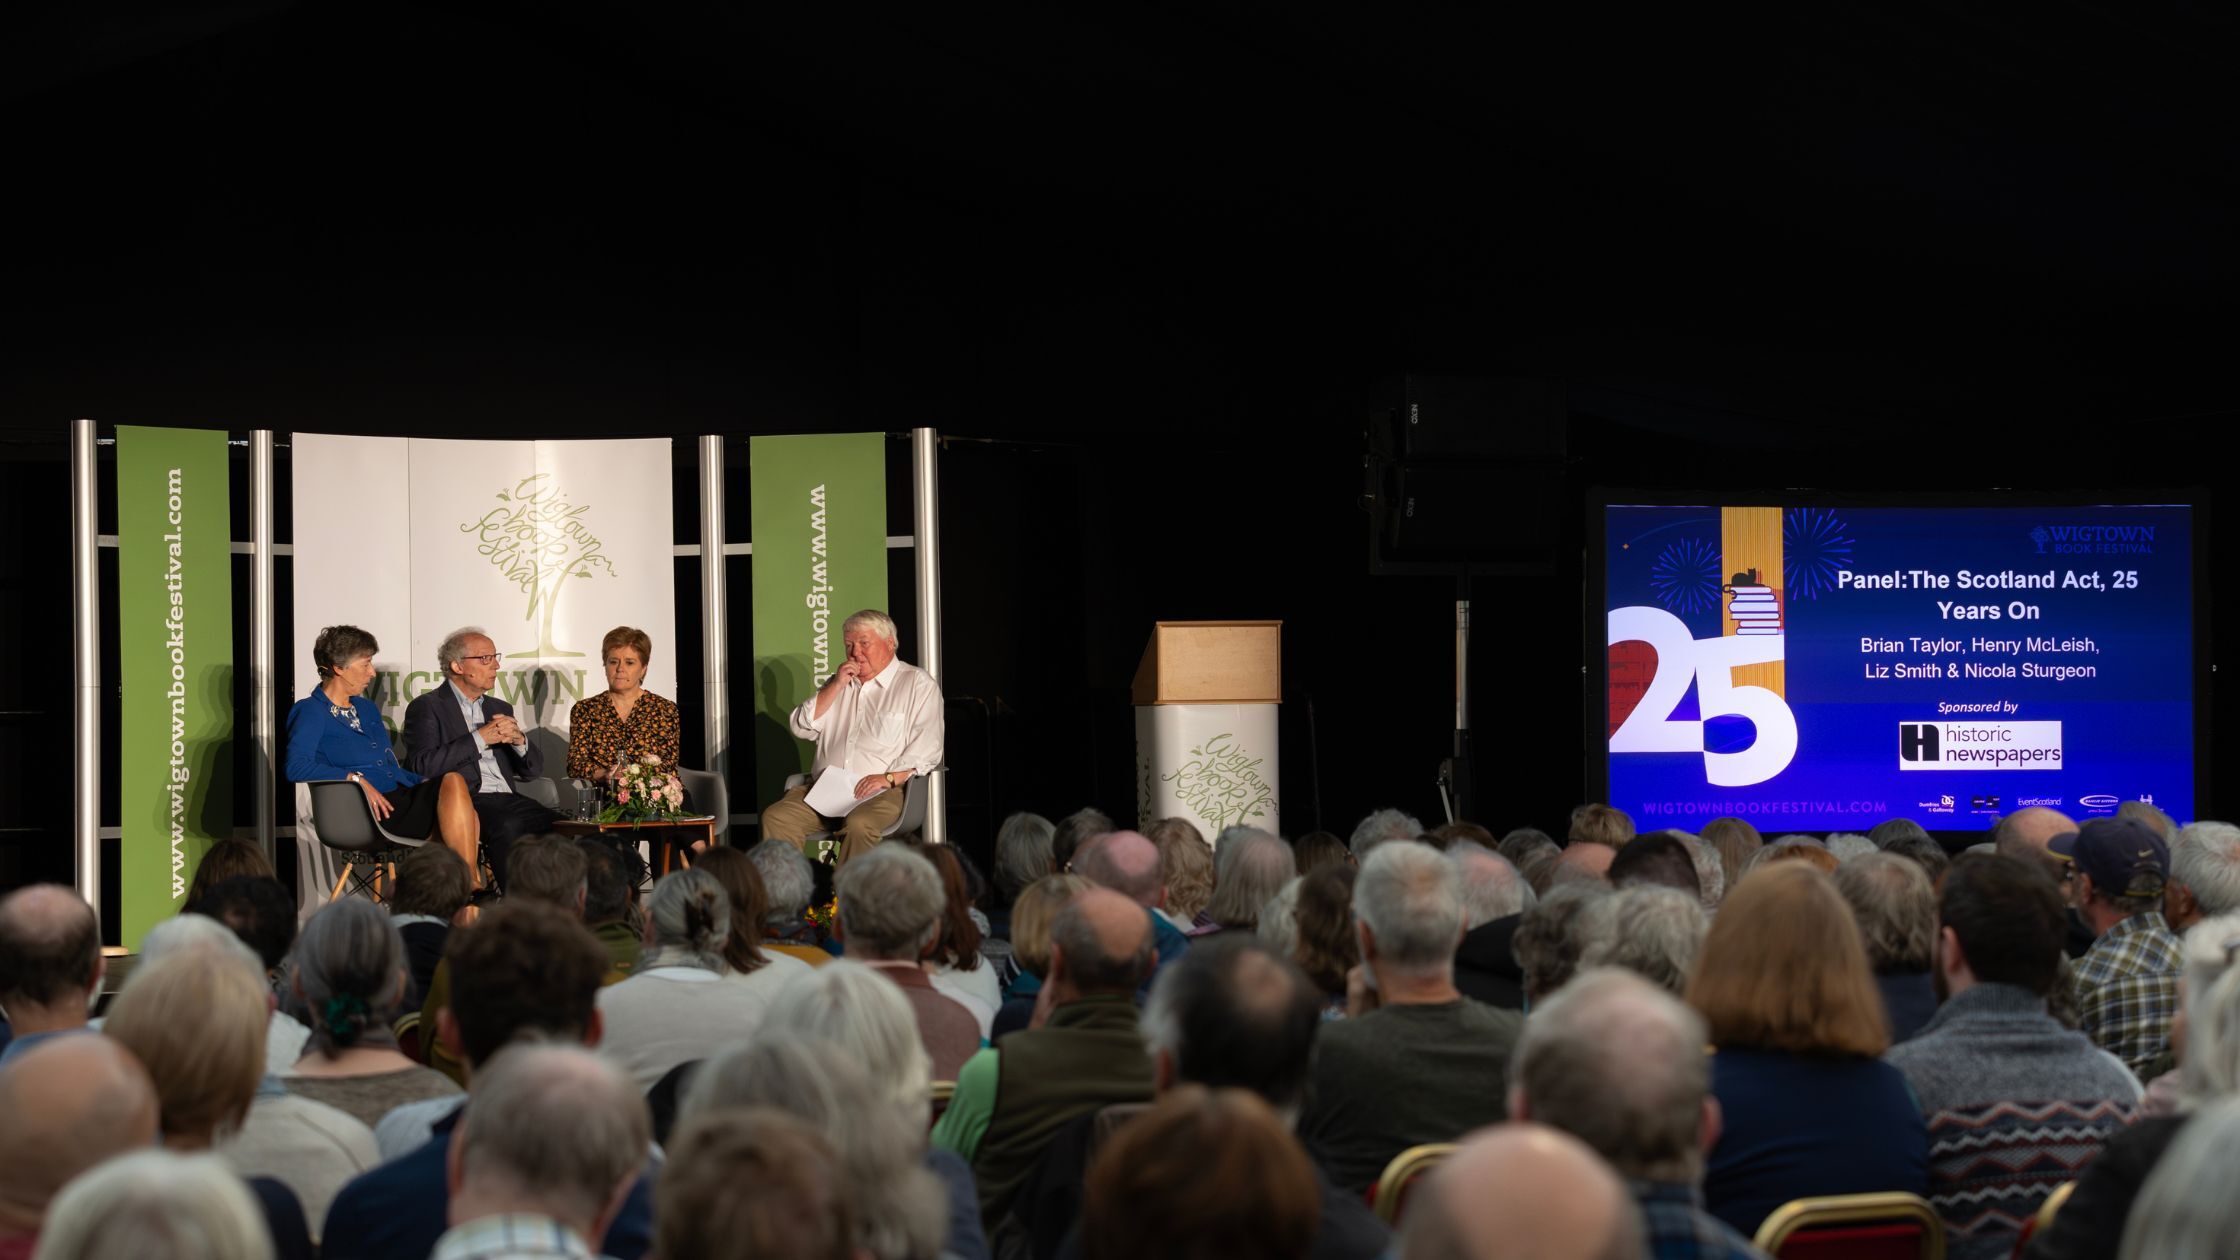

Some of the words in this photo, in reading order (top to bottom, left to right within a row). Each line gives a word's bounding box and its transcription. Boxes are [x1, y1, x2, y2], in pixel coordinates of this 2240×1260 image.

[2049, 526, 2156, 541] WIGTOWN
[2055, 543, 2091, 554] BOOK
[2096, 543, 2153, 554] FESTIVAL
[1957, 570, 2055, 588] Scotland
[2062, 570, 2105, 591] Act,
[2112, 570, 2138, 588] 25
[1937, 601, 2001, 619] Years
[2008, 601, 2040, 619] On
[1861, 637, 1904, 653] Brian
[1910, 637, 1966, 655] Taylor,
[1972, 637, 2021, 655] Henry
[2027, 636, 2100, 654] McLeish,
[1865, 663, 1889, 678] Liz
[1894, 663, 1941, 678] Smith
[1948, 663, 1959, 678] &
[1965, 663, 2016, 677] Nicola
[2022, 662, 2096, 681] Sturgeon
[166, 467, 190, 899] www.wigtownbookfestival.com
[1608, 606, 1798, 787] 25
[1938, 701, 2001, 715] Sponsored
[2003, 701, 2018, 714] by
[1946, 724, 2012, 742] historic
[1946, 748, 2061, 767] newspapers
[1643, 801, 1887, 815] WIGTOWNBOOKFESTIVAL.COM
[2017, 797, 2062, 806] EventScotland
